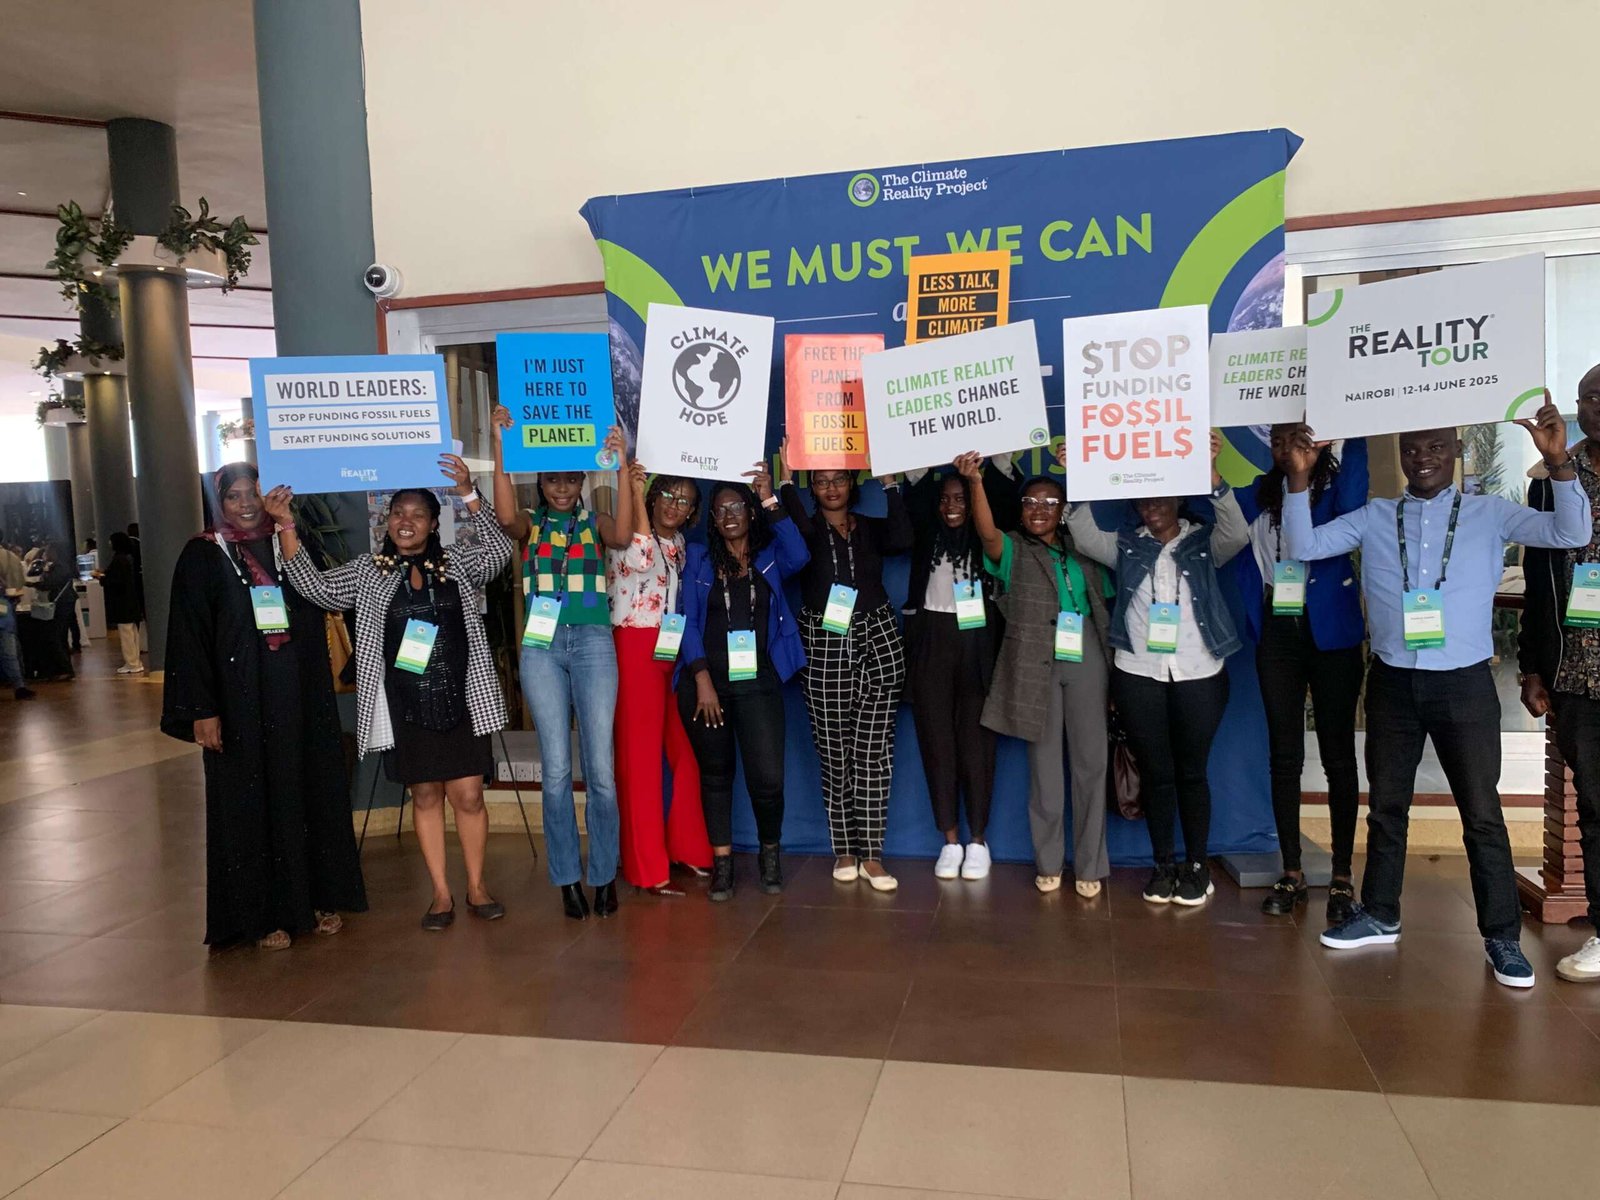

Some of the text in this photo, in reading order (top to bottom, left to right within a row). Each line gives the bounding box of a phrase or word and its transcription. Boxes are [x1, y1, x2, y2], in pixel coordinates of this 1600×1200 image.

[882, 167, 967, 187] The Climate
[883, 178, 988, 201] Reality Project
[700, 212, 1152, 294] WE MUST WE CAN
[923, 272, 994, 291] LESS TALK,
[938, 296, 977, 313] MORE
[928, 318, 985, 336] CLIMATE
[1349, 323, 1371, 335] THE
[670, 326, 750, 359] CLIMATE
[1348, 314, 1489, 359] REALITY
[804, 347, 837, 361] FREE
[1227, 350, 1285, 367] CLIMATE
[1417, 341, 1489, 368] TOUR
[524, 358, 585, 374] I'M JUST
[811, 369, 859, 385] PLANET
[886, 355, 1015, 396] CLIMATE REALITY
[1223, 368, 1283, 384] LEADERS
[276, 378, 428, 400] WORLD LEADERS:
[525, 381, 587, 397] HERE TO
[1082, 373, 1192, 400] FUNDING
[1239, 383, 1307, 400] THE WORL
[1345, 374, 1499, 402] NAIROBI 12-14 JUNE 2025
[816, 392, 853, 406] FROM
[887, 378, 1020, 419] LEADERS CHANGE
[278, 409, 431, 423] STOP FUNDING FOSSIL FUELS
[522, 404, 593, 420] SAVE THE
[678, 407, 728, 427] HOPE
[813, 414, 858, 429] FOSSIL
[909, 406, 1002, 437] THE WORLD.
[283, 430, 431, 445] START FUNDING SOLUTIONS
[529, 427, 590, 443] PLANET.
[814, 436, 858, 451] FUELS.
[681, 454, 719, 466] REALITY
[341, 469, 376, 478] REALITY
